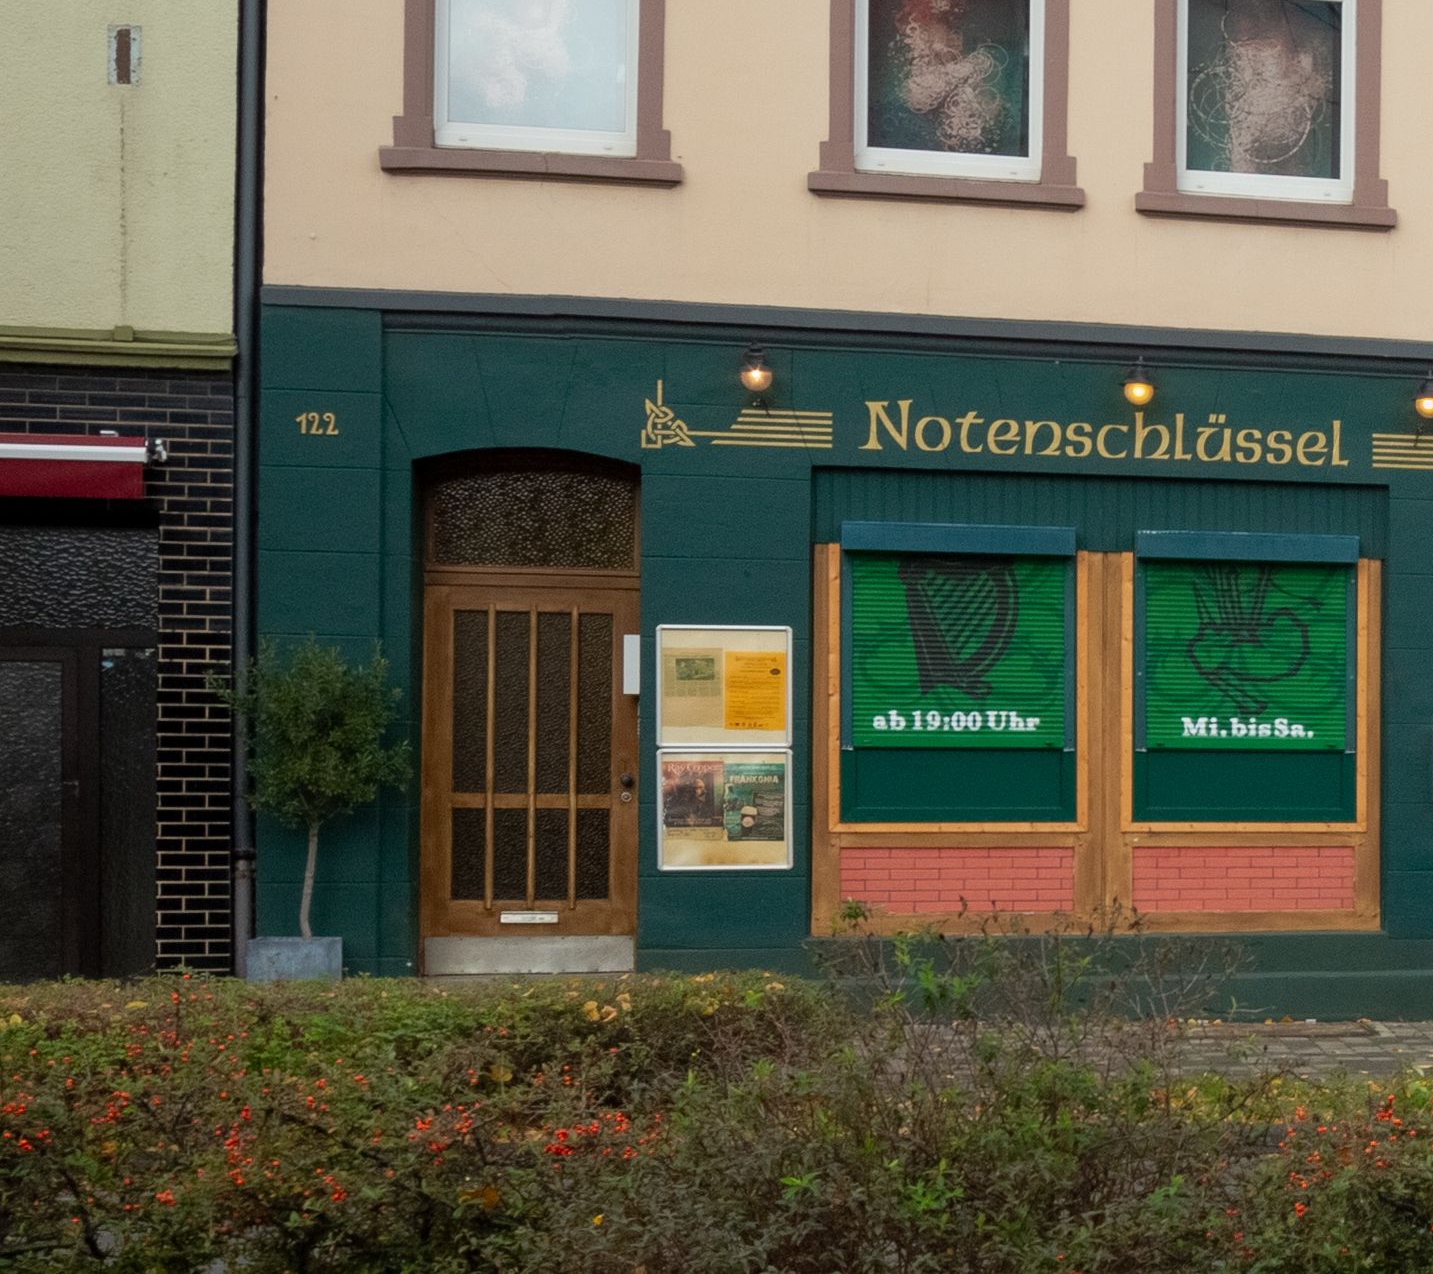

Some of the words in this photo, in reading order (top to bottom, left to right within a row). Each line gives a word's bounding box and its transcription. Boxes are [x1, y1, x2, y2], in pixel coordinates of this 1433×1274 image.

[295, 412, 339, 435] 122
[858, 399, 1350, 467] Notenschlüssel
[872, 710, 906, 731] ab
[912, 710, 982, 732] 19:00
[986, 710, 1041, 732] Uhr
[1181, 716, 1227, 738] Mi.
[1229, 717, 1272, 738] bis
[1274, 717, 1315, 739] Sa.
